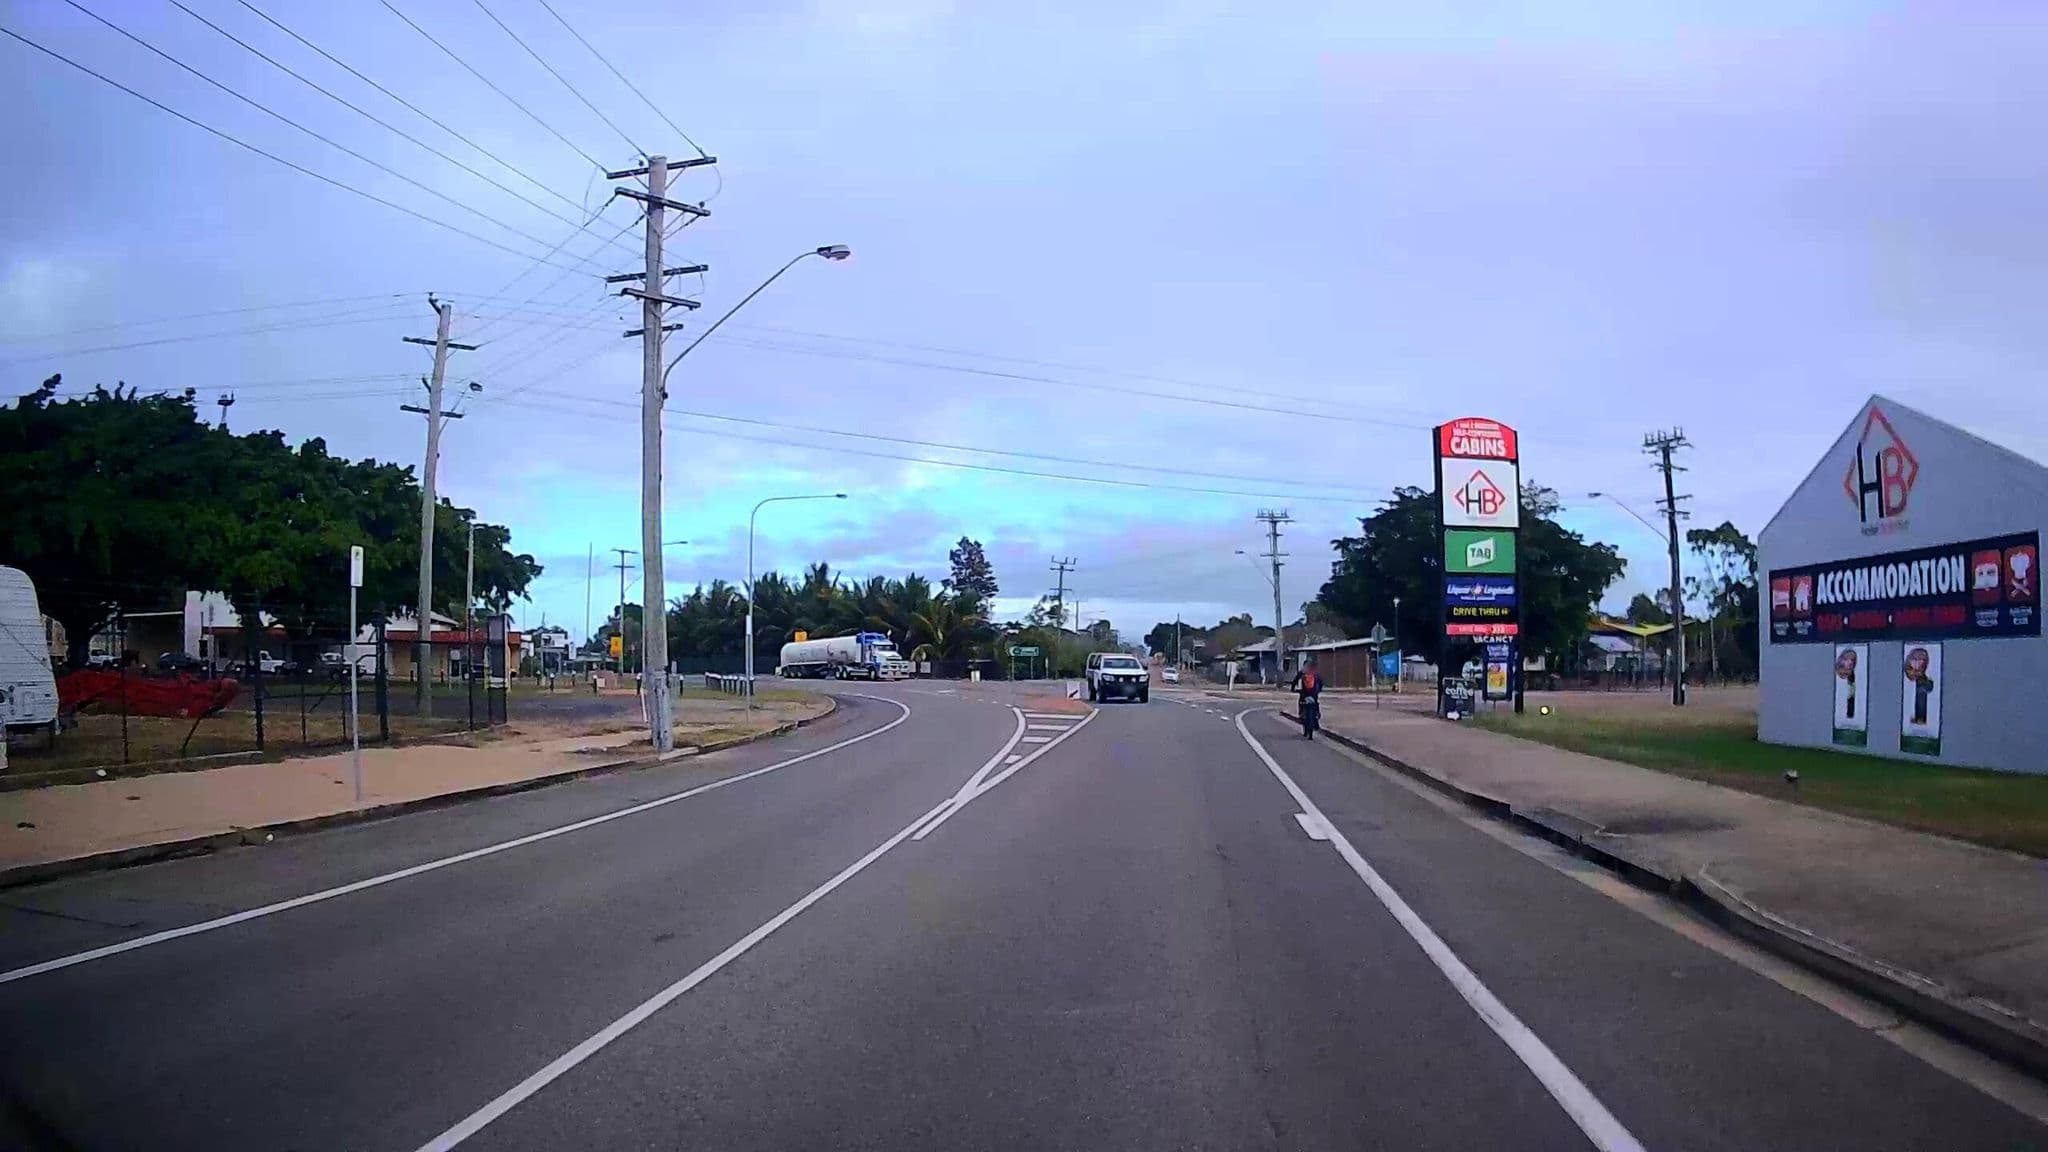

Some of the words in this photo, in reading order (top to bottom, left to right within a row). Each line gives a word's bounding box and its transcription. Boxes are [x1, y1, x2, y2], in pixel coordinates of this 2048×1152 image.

[1450, 437, 1506, 457] CABINS
[1856, 441, 1908, 522] HB
[1466, 482, 1498, 514] HB
[1470, 547, 1491, 559] TAB
[1816, 554, 1966, 605] ACCOMMODATION
[1453, 607, 1477, 616] DRIVE
[1478, 607, 1500, 616] THRU
